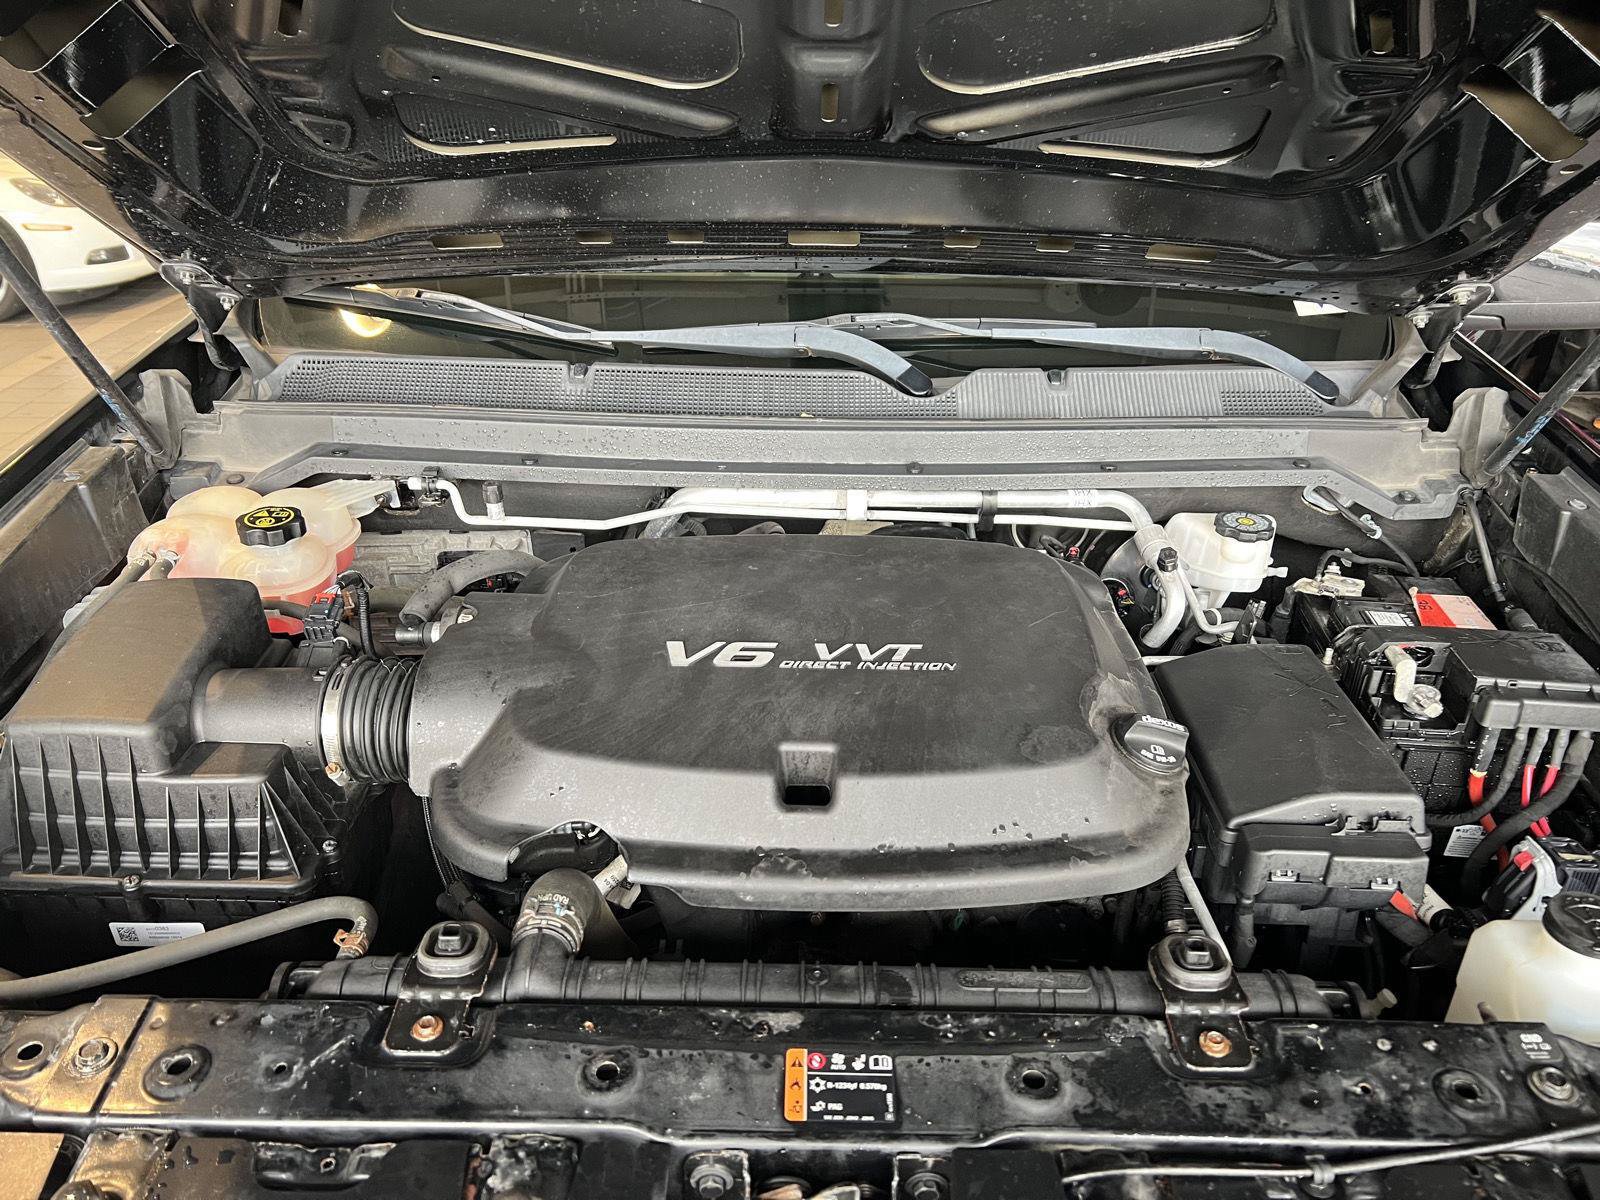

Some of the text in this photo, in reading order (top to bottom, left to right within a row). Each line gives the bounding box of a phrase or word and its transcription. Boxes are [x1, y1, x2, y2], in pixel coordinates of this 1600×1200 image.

[666, 641, 779, 668] V6
[814, 643, 923, 661] VVT
[779, 660, 957, 671] DIRECT INJECTION
[553, 893, 570, 905] RAD
